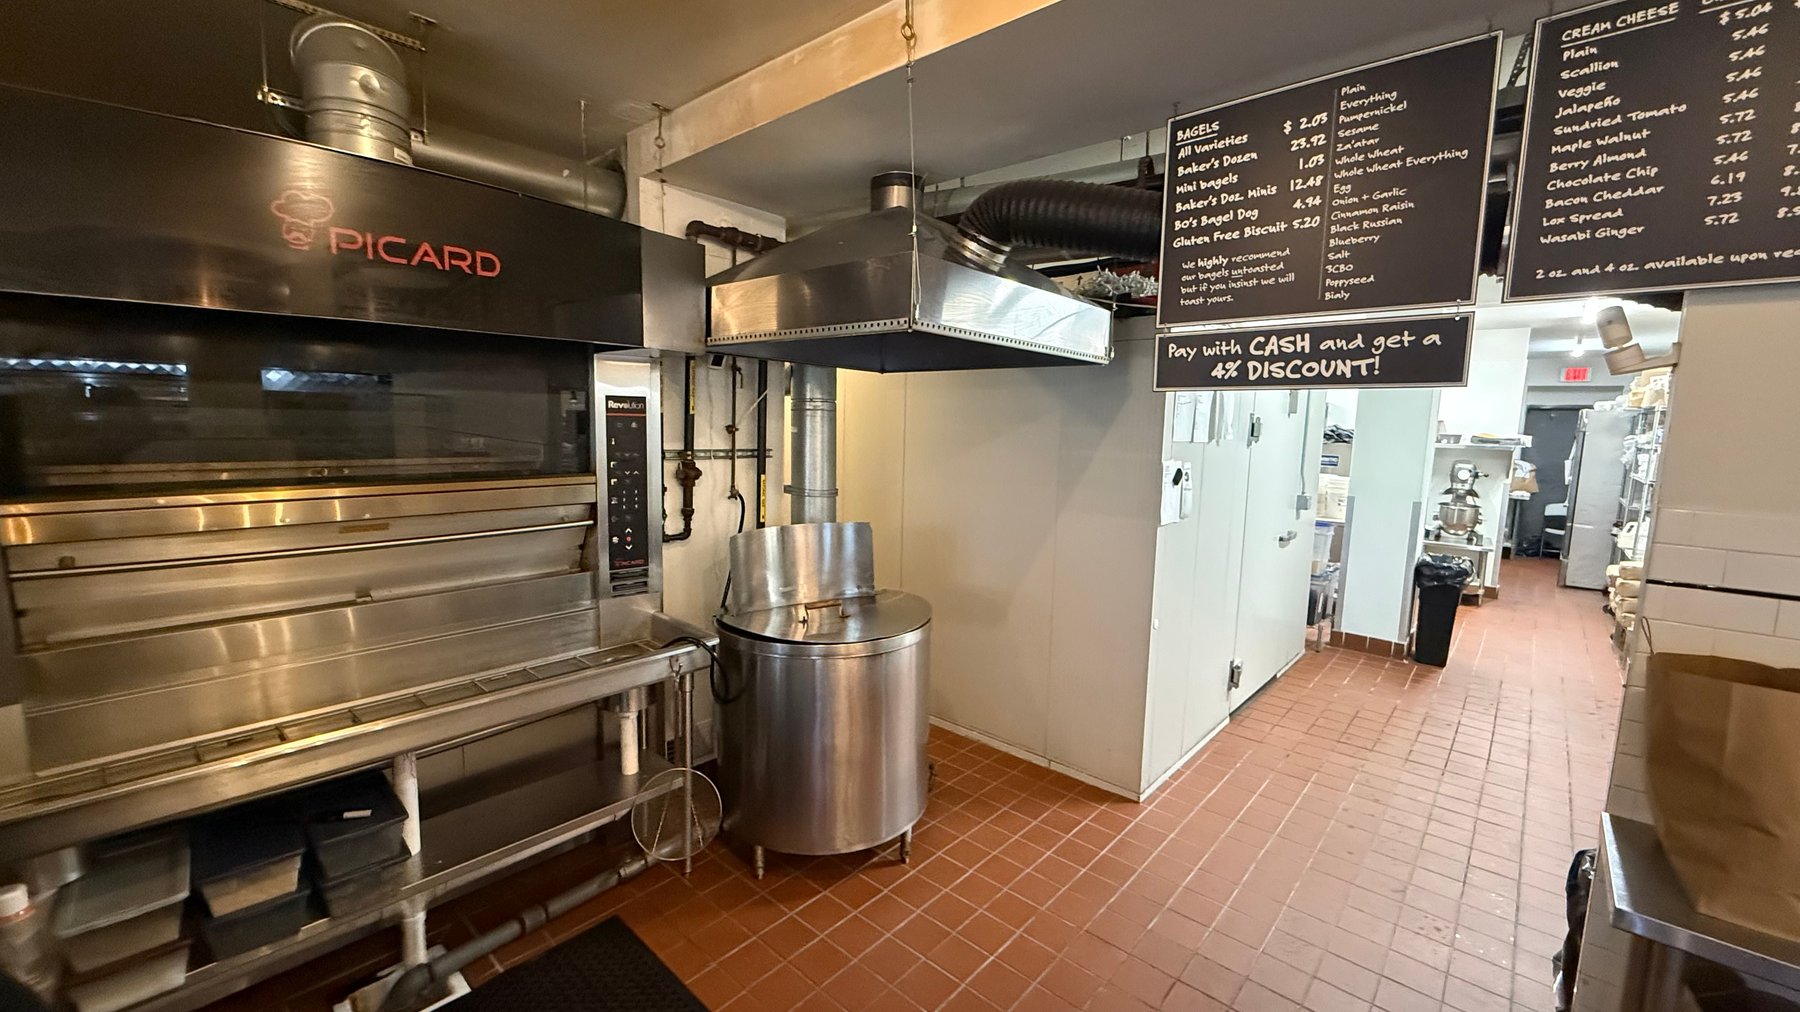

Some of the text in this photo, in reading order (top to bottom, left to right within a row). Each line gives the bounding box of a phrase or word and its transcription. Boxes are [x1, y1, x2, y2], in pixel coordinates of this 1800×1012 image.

[1561, 2, 1680, 42] CREAM CHEESE
[1563, 2, 1773, 61] Plain $ 5.04
[1560, 23, 1769, 79] Scallion 5.46
[1729, 45, 1765, 62] 5.46
[1340, 91, 1397, 110] Everything
[1341, 84, 1366, 96] Plain
[1555, 66, 1762, 119] Jalapeño 5.46
[1339, 98, 1407, 124] Pumpernickel
[1553, 88, 1759, 135] Sundried Tomato 5.46
[1176, 121, 1220, 141] BAGELS
[1178, 112, 1328, 160] All Varieties $ 2.03
[1337, 123, 1379, 137] Sesame
[1551, 109, 1756, 154] Maple Walnut 5.72
[1177, 134, 1327, 177] Baker's Dozen 23.92
[1336, 138, 1380, 152] Za'atar
[1549, 130, 1752, 173] Berry Almond 5.72
[1334, 167, 1364, 178] Whole
[1406, 149, 1468, 167] Everything
[1335, 153, 1365, 165] Whole
[1547, 173, 1621, 191] Chocolate
[1626, 166, 1658, 179] Chip
[1713, 151, 1748, 165] 5.46
[1176, 154, 1325, 194] Mini bagels 1.03
[1175, 195, 1217, 213] Baker's
[1248, 185, 1277, 198] Minis
[1290, 175, 1324, 191] 12.48
[1332, 196, 1359, 206] Onion
[1372, 187, 1407, 200] Garlic
[1333, 184, 1351, 195] Egg
[1545, 196, 1588, 209] Bacon
[1593, 186, 1664, 202] Cheddar
[1710, 171, 1746, 185] 6.19
[1201, 210, 1233, 226] Bagel
[1237, 208, 1259, 220] Dog
[1293, 195, 1322, 209] 4.94
[1331, 200, 1415, 220] Cinnamon Raisin
[1543, 217, 1565, 227] Lox
[1569, 208, 1624, 224] Spread
[1707, 191, 1742, 206] 7.23
[1173, 216, 1320, 248] Gluten Free Biscuit 5.20
[1330, 217, 1403, 234] Black Russian
[1540, 230, 1591, 244] Wasabi
[1595, 226, 1645, 239] Ginger
[1704, 212, 1739, 225] 5.72
[328, 225, 501, 278] PICARD
[1329, 235, 1380, 247] Blueberry
[1198, 255, 1229, 269] highly
[1231, 247, 1290, 262] recommend
[1327, 250, 1351, 260] Salt
[1536, 269, 1545, 279] 2
[1571, 265, 1601, 276] and
[1604, 263, 1615, 272] 4
[1644, 253, 1724, 269] available
[1730, 252, 1768, 264] upon
[1180, 272, 1295, 294] but if you insinst we will
[1198, 268, 1229, 281] bagels
[1231, 261, 1284, 275] untoasted
[1325, 274, 1375, 288] Poppyseed
[1180, 295, 1234, 306] toast yours.
[1325, 290, 1350, 300] Bialy
[1169, 330, 1442, 362] Pay with CASH and get a
[1211, 355, 1380, 381] 4% DISCOUNT!
